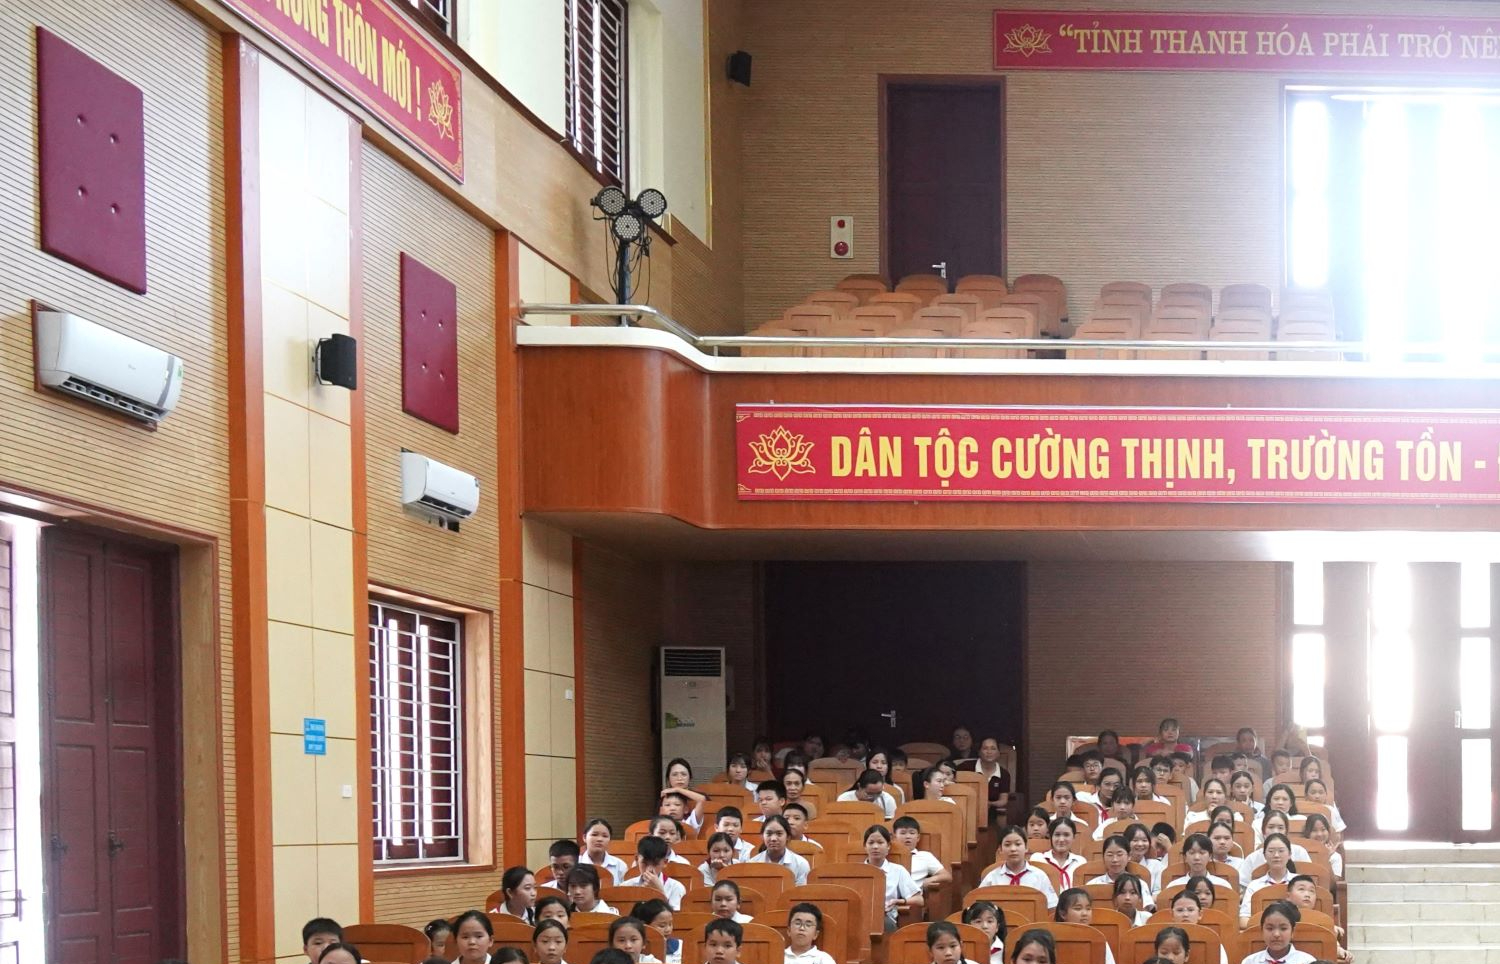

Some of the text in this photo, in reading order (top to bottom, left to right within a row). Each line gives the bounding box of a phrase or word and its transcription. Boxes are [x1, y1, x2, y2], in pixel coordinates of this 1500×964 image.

[334, 2, 380, 88] THÔN
[381, 35, 413, 115] MỚI
[415, 65, 422, 122] !
[1150, 29, 1249, 55] THANH
[1255, 23, 1316, 57] HÓA
[1322, 24, 1390, 58] PHẢI
[1398, 25, 1452, 59] TRỞ
[831, 427, 902, 477] DÂN
[914, 428, 979, 487] TỘC
[992, 428, 1110, 480] CƯỜNG
[1121, 438, 1236, 489] THỊNH,
[1248, 429, 1384, 481] TRƯỜNG
[1396, 426, 1462, 482] TỒN
[1474, 459, 1486, 469] -
